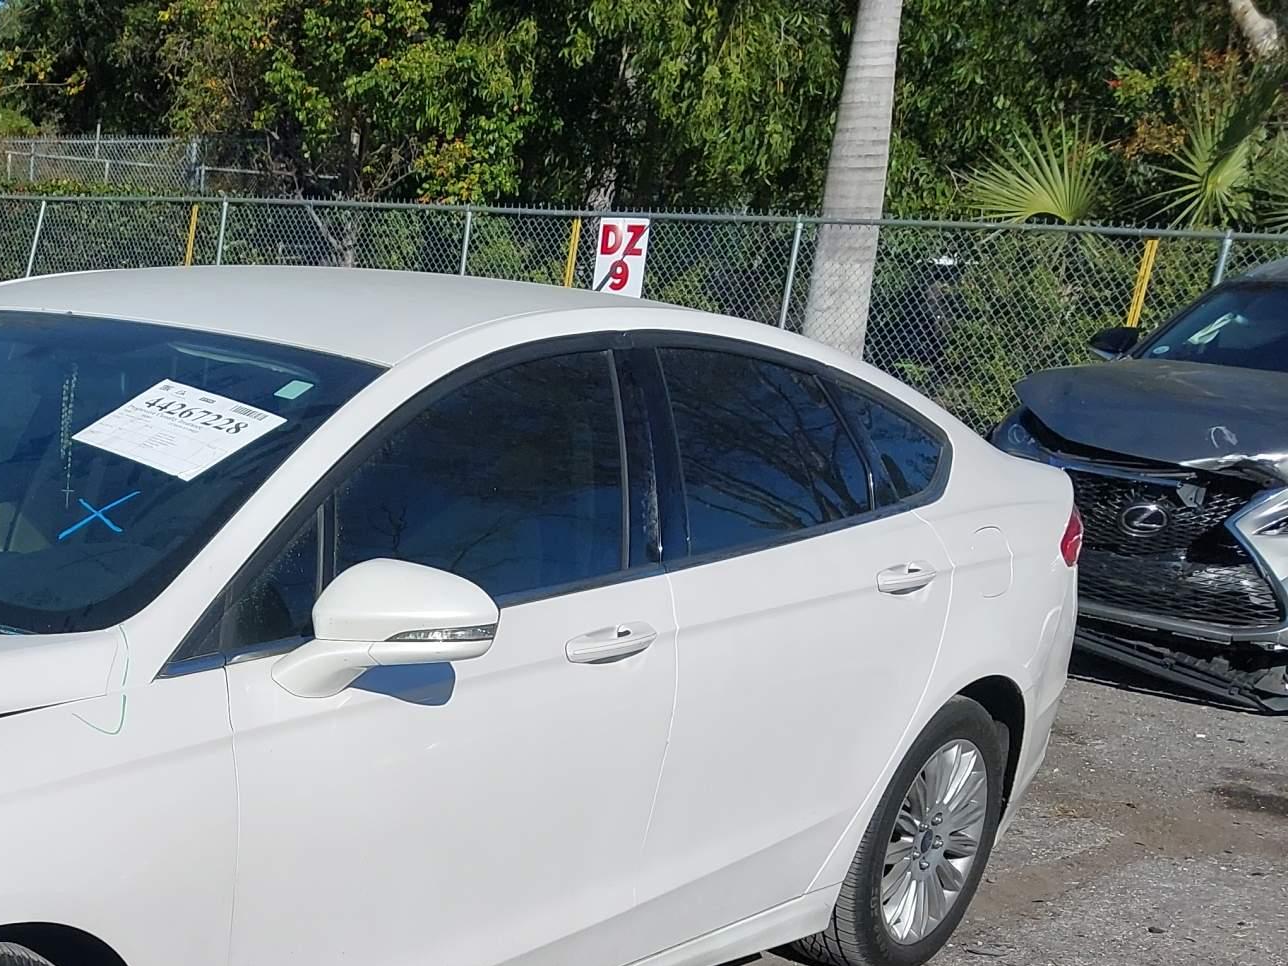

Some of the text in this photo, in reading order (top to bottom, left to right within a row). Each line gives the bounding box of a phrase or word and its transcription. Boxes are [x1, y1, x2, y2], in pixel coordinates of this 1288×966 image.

[600, 223, 647, 257] DZ
[608, 259, 630, 291] 9
[145, 397, 249, 435] 44267228
